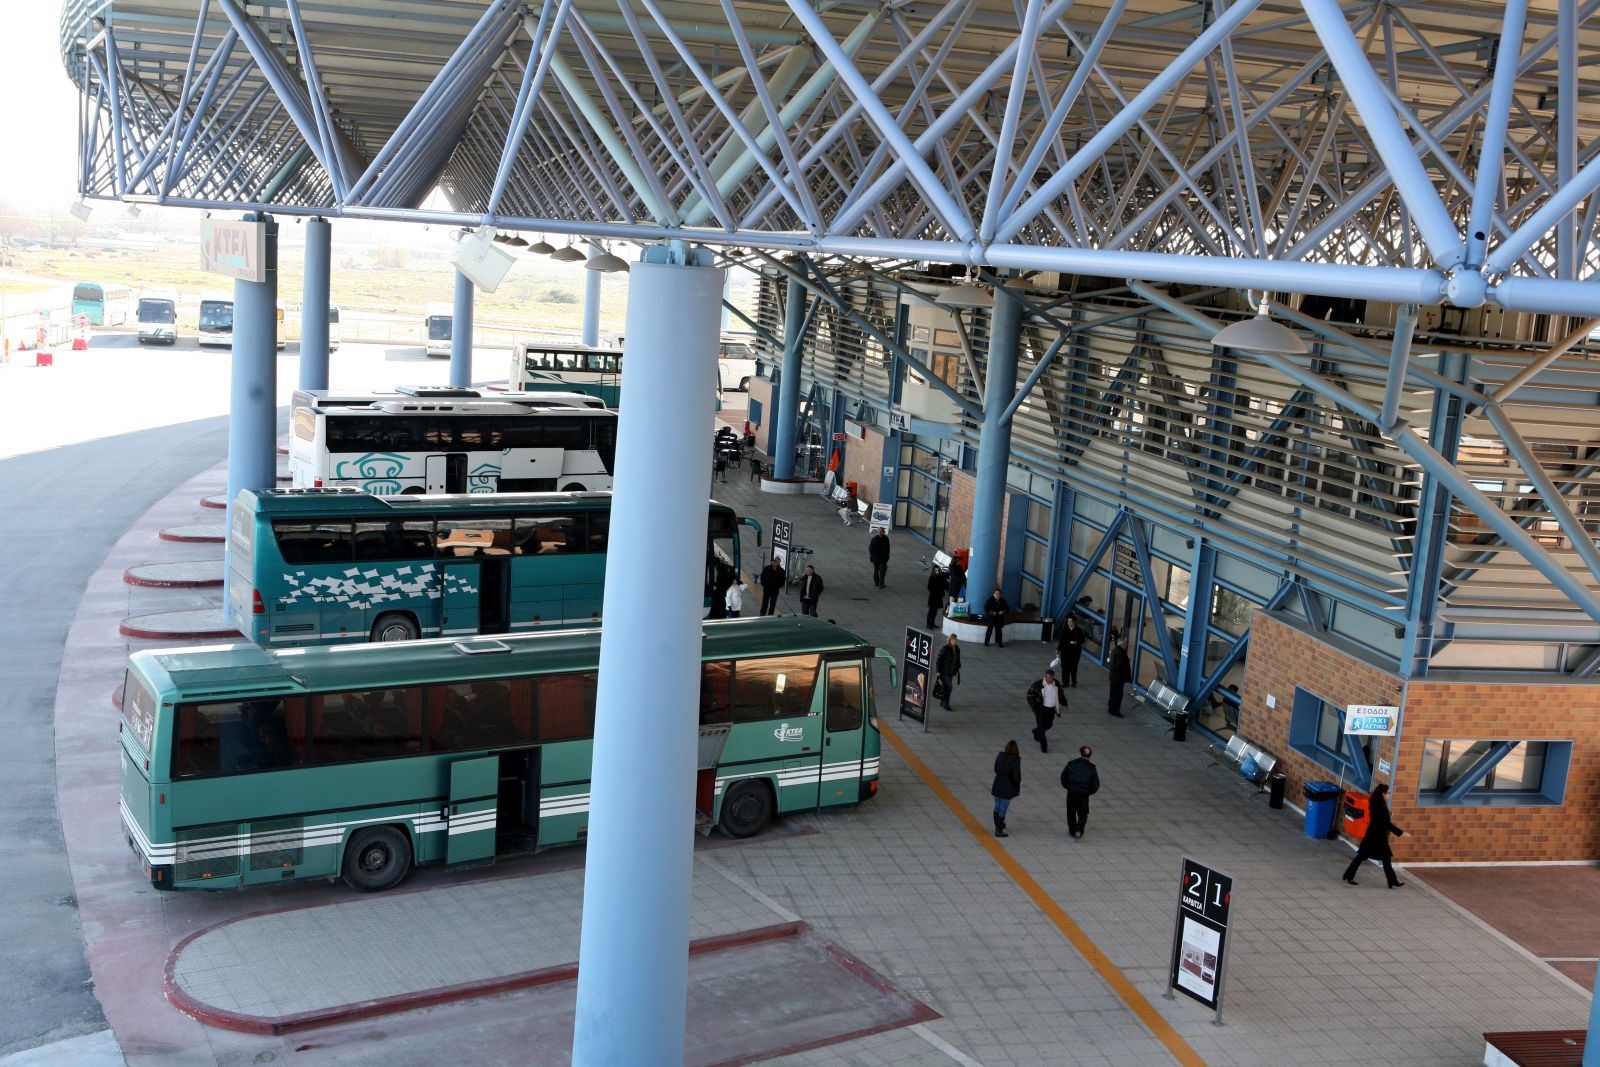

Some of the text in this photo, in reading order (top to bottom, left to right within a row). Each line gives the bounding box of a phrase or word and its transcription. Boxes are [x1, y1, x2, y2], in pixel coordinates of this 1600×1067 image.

[214, 227, 250, 268] ΚΤΕΛ
[775, 523, 781, 536] 6
[783, 526, 789, 538] 5
[909, 636, 917, 652] 4
[921, 640, 929, 657] 3
[1356, 707, 1389, 715] ΕΞΟΔΟΣ
[1188, 871, 1202, 897] 2
[1212, 882, 1222, 907] 1
